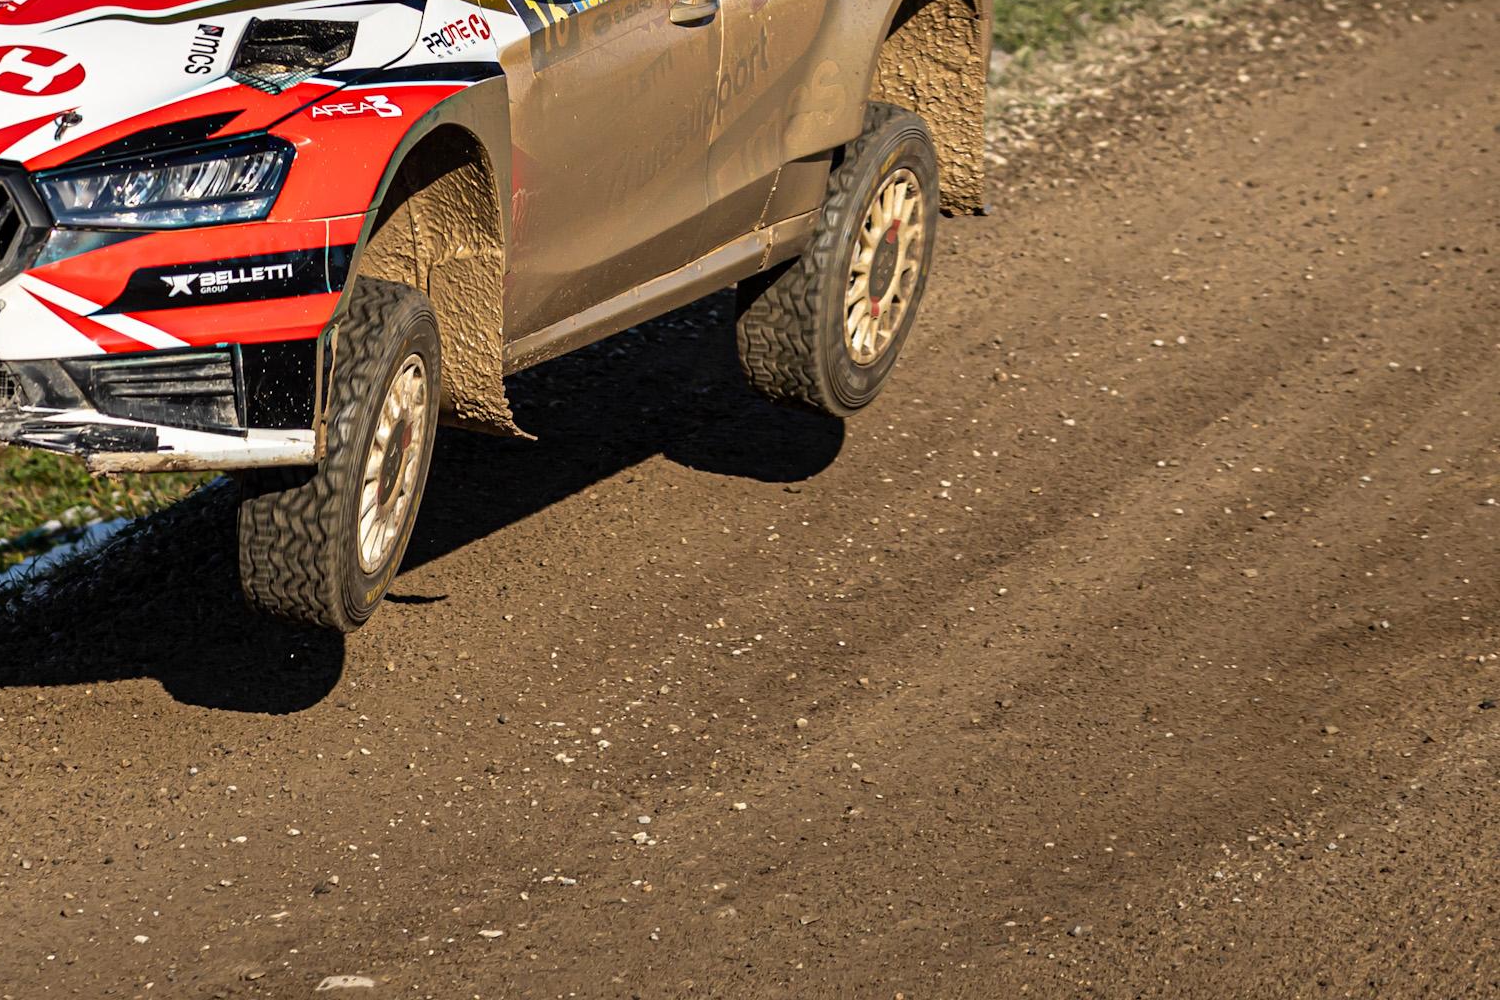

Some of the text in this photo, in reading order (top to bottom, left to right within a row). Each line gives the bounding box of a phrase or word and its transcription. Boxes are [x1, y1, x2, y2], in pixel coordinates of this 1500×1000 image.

[184, 36, 221, 74] mcs
[312, 94, 403, 118] AREA3
[200, 263, 294, 288] BELLETTI
[200, 284, 229, 295] GROUP
